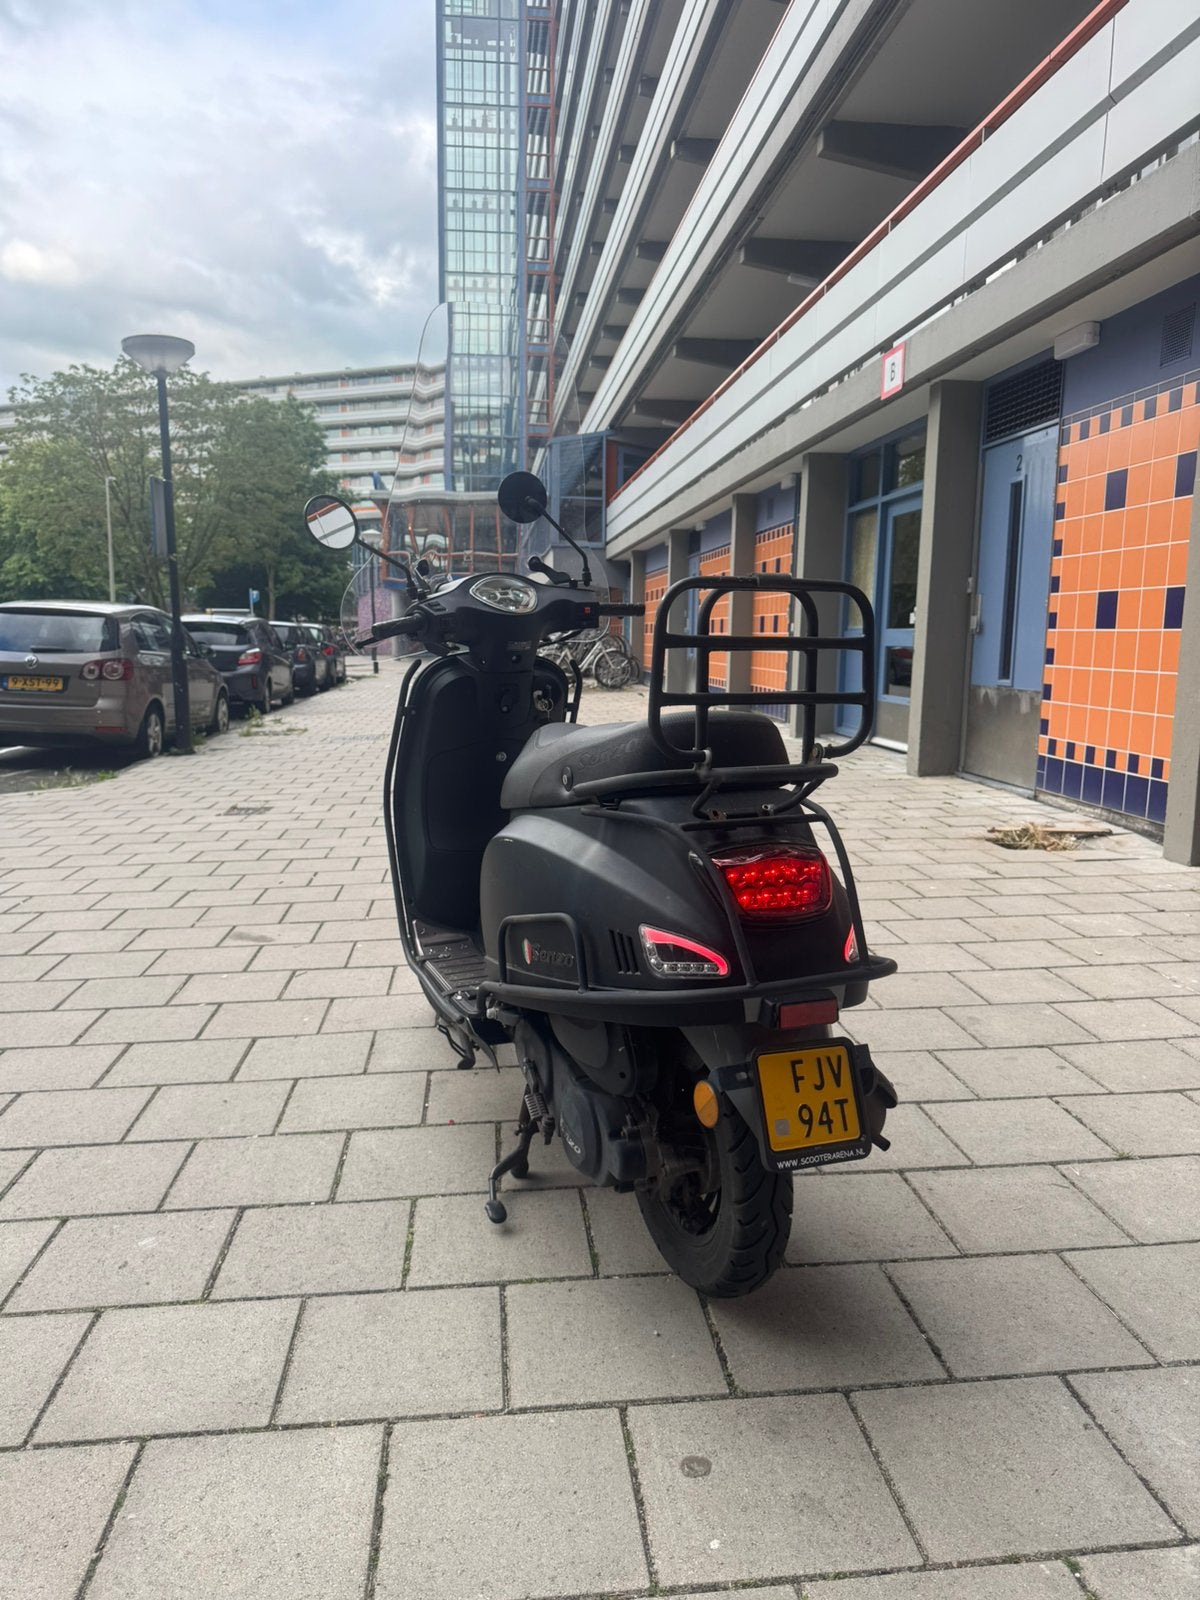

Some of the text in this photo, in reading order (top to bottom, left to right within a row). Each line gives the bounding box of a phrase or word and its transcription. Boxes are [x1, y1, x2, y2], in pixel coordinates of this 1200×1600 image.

[1016, 454, 1023, 472] 2
[790, 1055, 843, 1093] FJV
[798, 1098, 849, 1138] 94T
